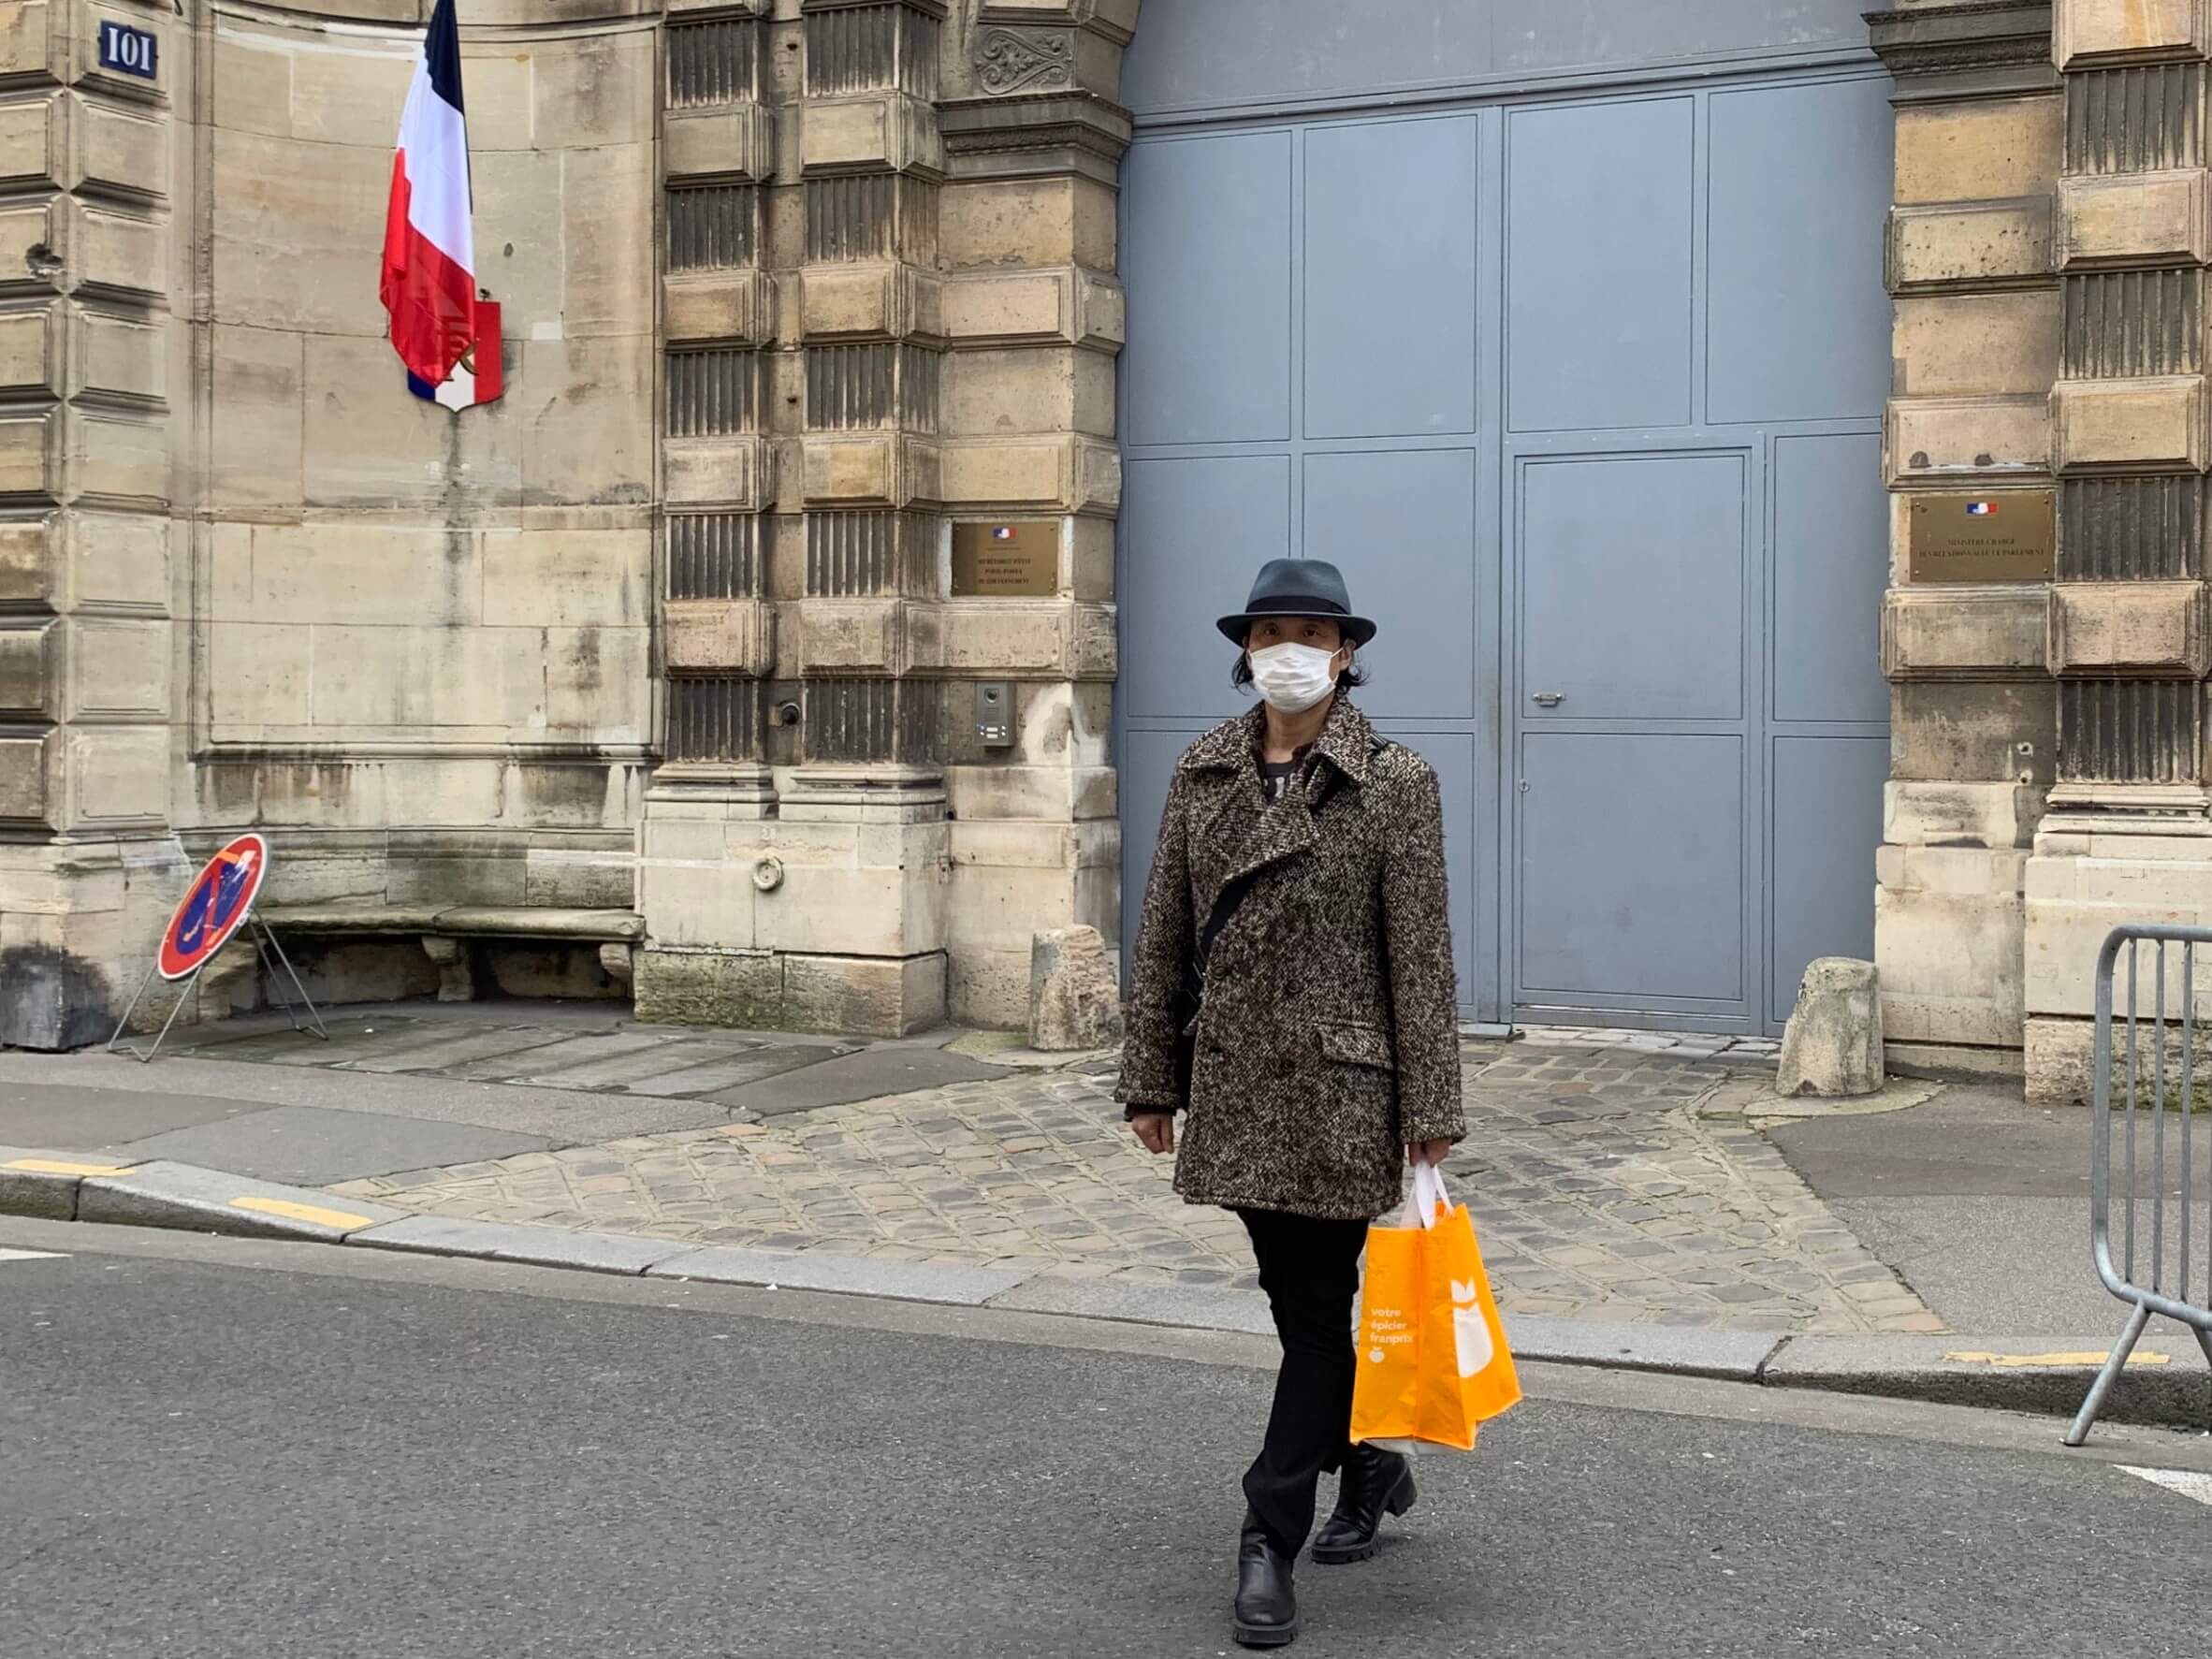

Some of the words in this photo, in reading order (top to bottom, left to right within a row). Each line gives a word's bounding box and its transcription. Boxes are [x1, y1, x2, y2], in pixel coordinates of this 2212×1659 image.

[108, 27, 151, 71] 101
[1370, 1308, 1402, 1317] votre
[1369, 1332, 1415, 1346] franprix
